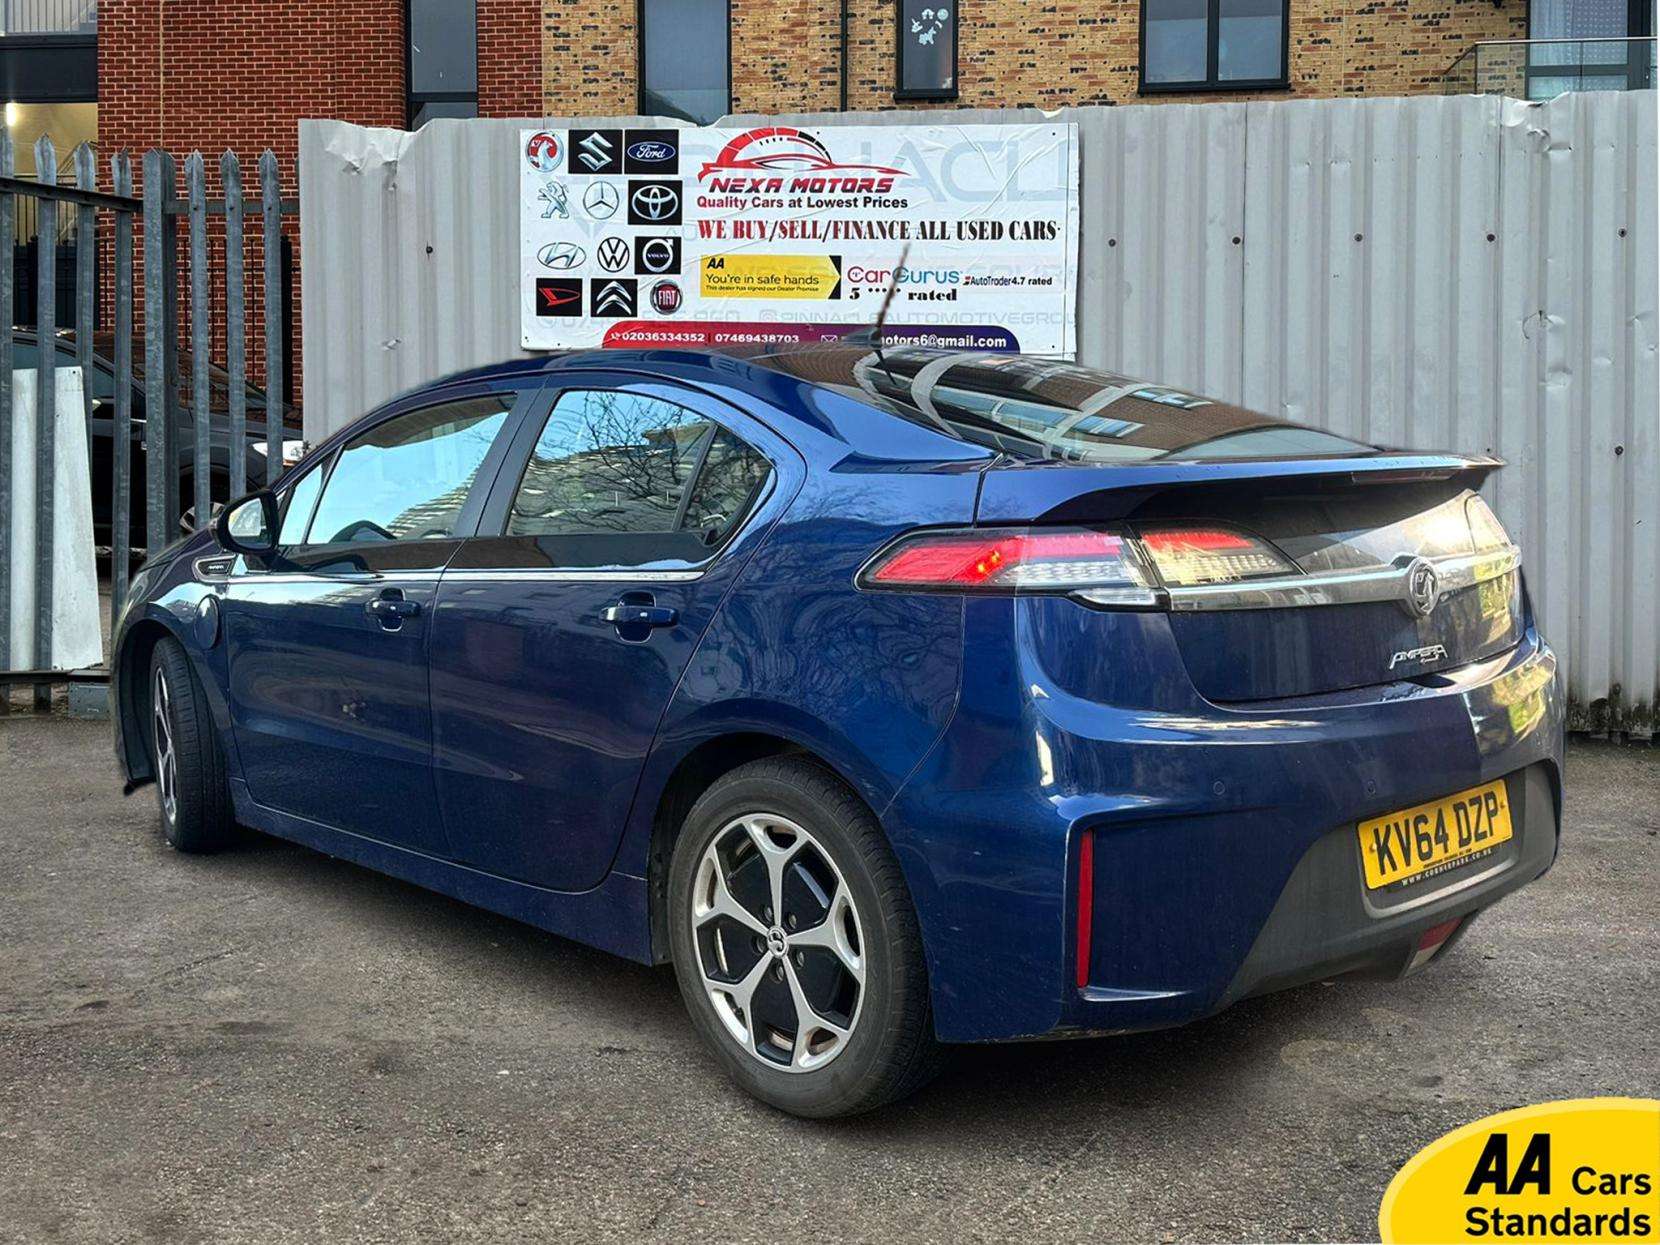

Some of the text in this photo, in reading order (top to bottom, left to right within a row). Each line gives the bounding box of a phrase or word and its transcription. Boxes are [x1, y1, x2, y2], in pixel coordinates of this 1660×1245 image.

[636, 144, 666, 158] Ford
[708, 178, 894, 193] NEXA MOTORS
[697, 196, 908, 210] Quality Cars at Lowest Prices
[697, 220, 726, 241] WE
[733, 219, 911, 243] BUY/SELL/FINANCE
[916, 220, 951, 241] ALL
[956, 220, 1003, 241] USED
[1008, 220, 1058, 241] CARS
[707, 257, 725, 269] AA
[705, 273, 819, 285] You're in safe hands
[1028, 277, 1053, 286] rated
[658, 290, 677, 306] FIAT
[849, 287, 958, 301] 5 rated
[622, 333, 705, 342] 02036334352
[715, 334, 800, 343] 07469438703
[1373, 791, 1500, 875] KV64 DZP
